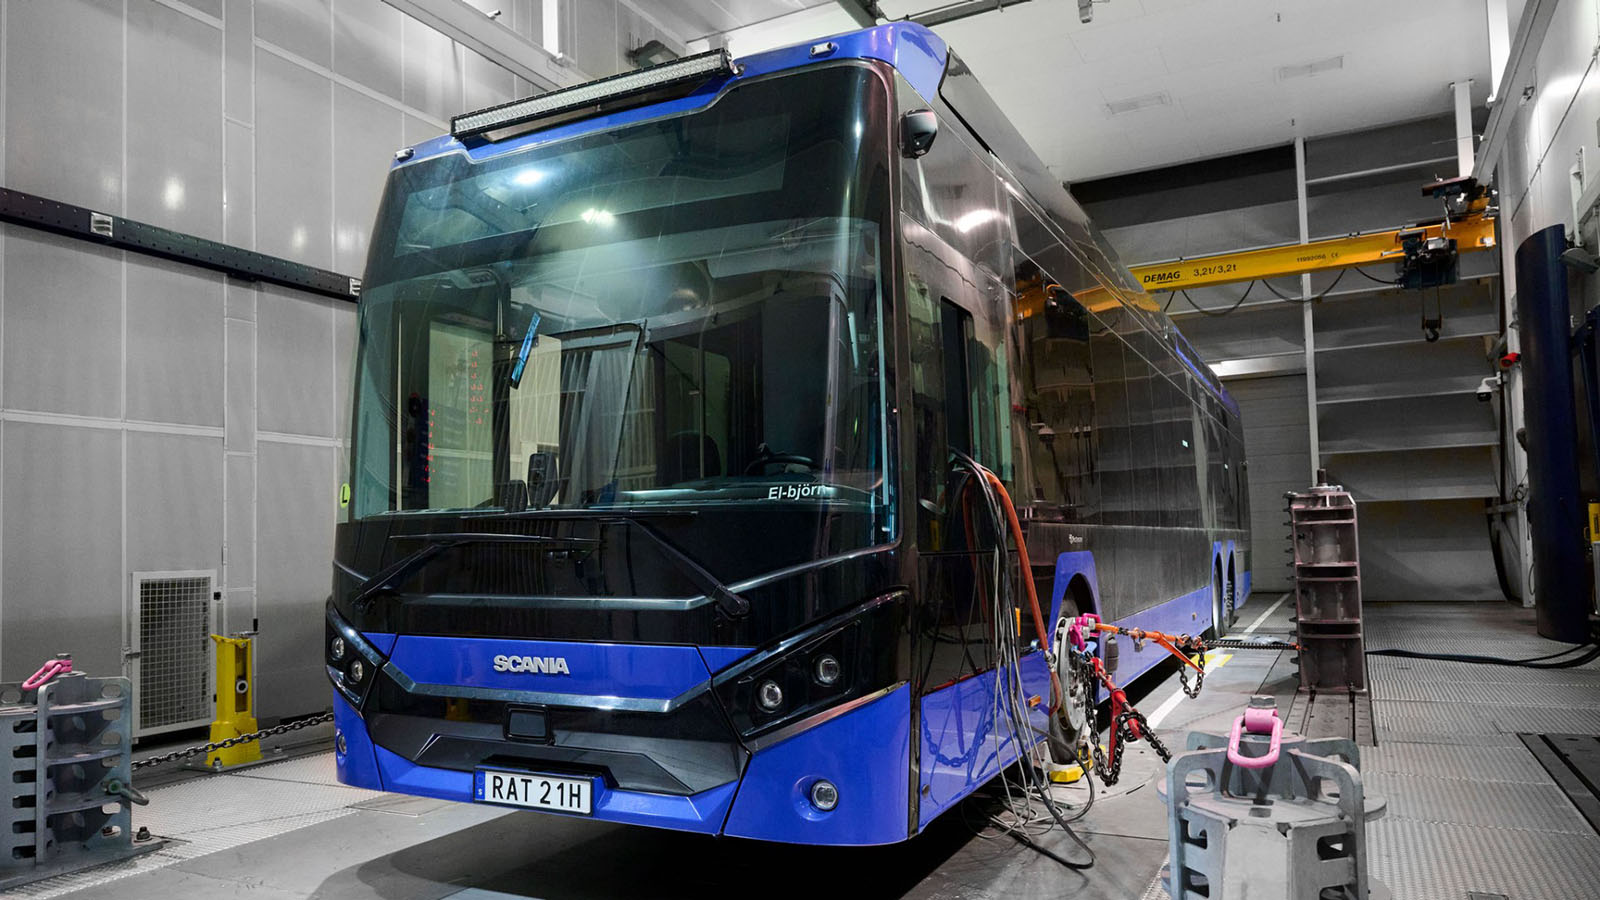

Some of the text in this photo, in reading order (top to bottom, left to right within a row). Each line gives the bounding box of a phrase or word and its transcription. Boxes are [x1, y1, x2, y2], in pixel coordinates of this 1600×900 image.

[1143, 271, 1180, 283] DEMAG
[493, 655, 570, 675] SCANIA
[478, 775, 581, 809] S RAT 21H
